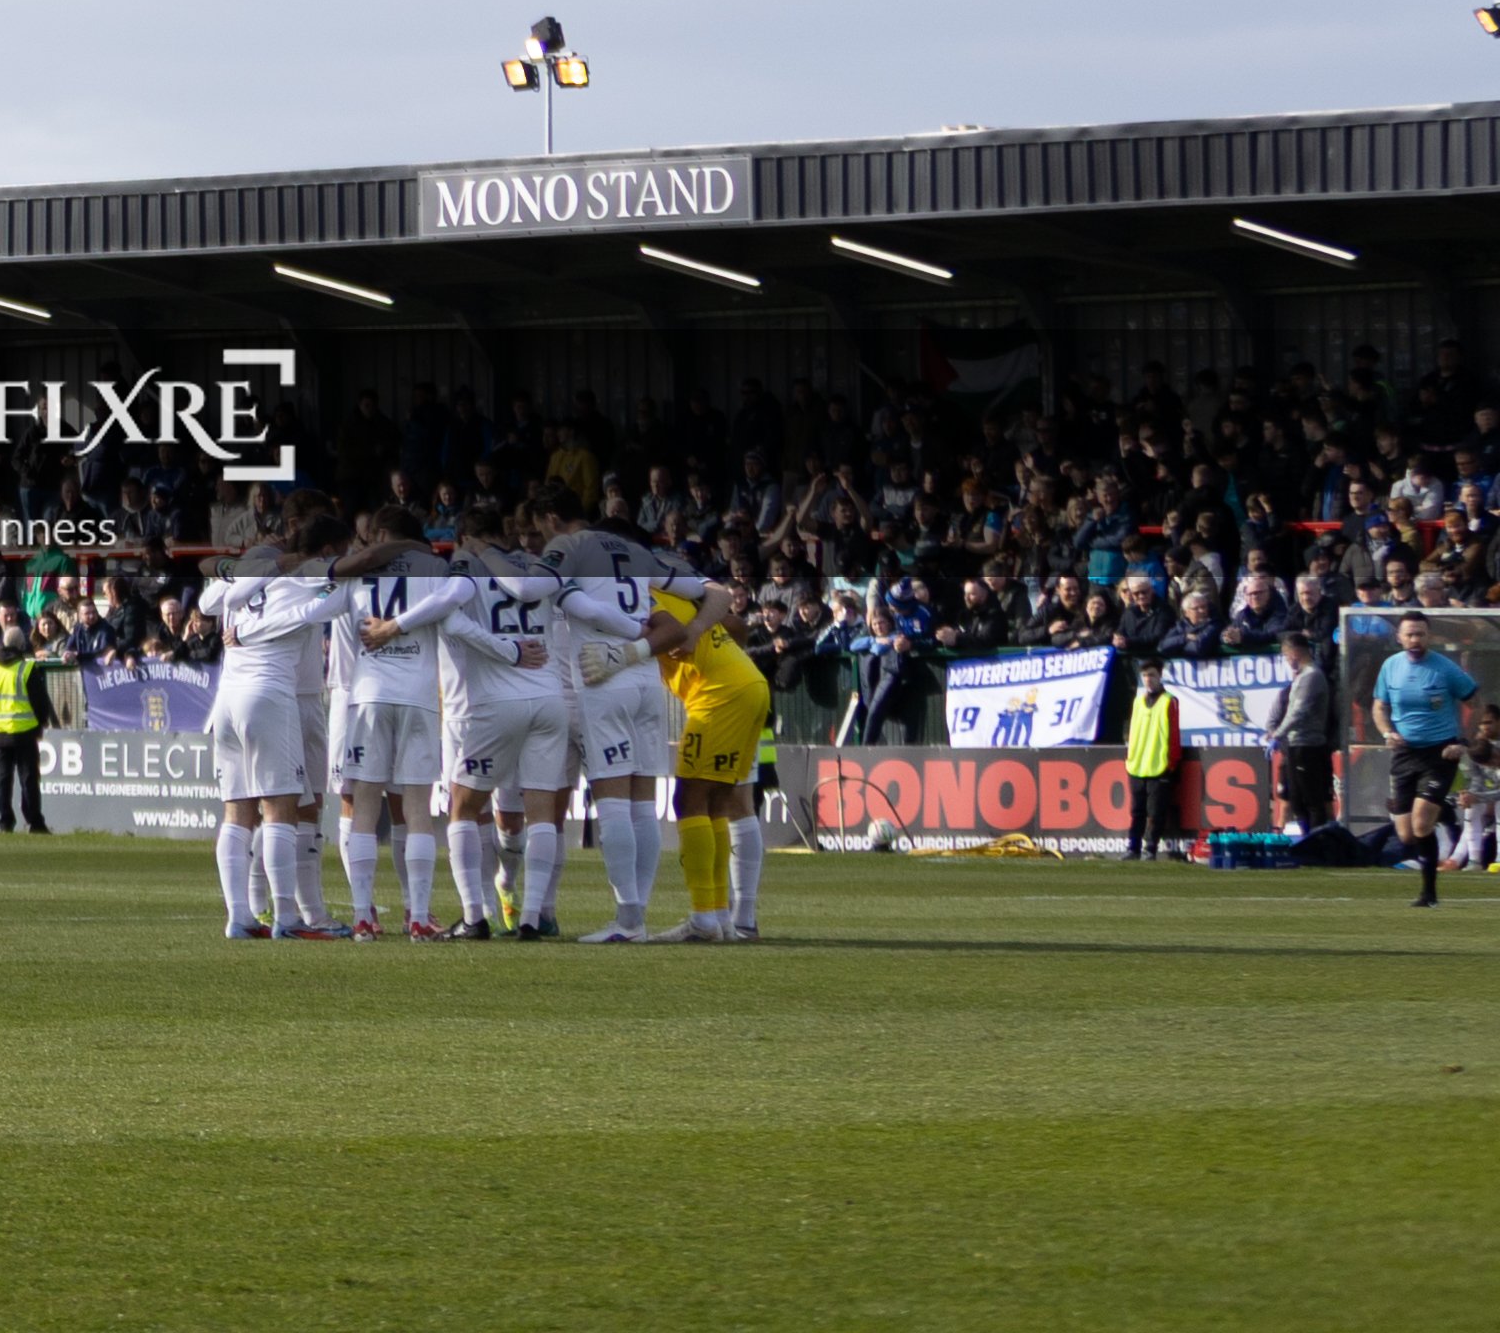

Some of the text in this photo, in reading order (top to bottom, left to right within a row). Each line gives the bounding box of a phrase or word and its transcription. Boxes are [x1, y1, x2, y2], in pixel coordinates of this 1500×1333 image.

[435, 167, 734, 228] MONO STAND
[611, 553, 640, 614] 5
[362, 573, 409, 637] 14
[488, 576, 545, 635] 22
[949, 648, 1109, 687] WATERFORD SENIORS
[953, 697, 1083, 734] 19 30
[101, 742, 218, 779] ELECT
[464, 757, 494, 776] PF
[603, 740, 631, 766] PF
[714, 751, 740, 772] PF
[40, 782, 94, 797] LECTRICAL
[96, 783, 160, 798] ENGINEERING
[816, 759, 1260, 831] BONOBOS
[133, 808, 217, 829] www.dbe.ie
